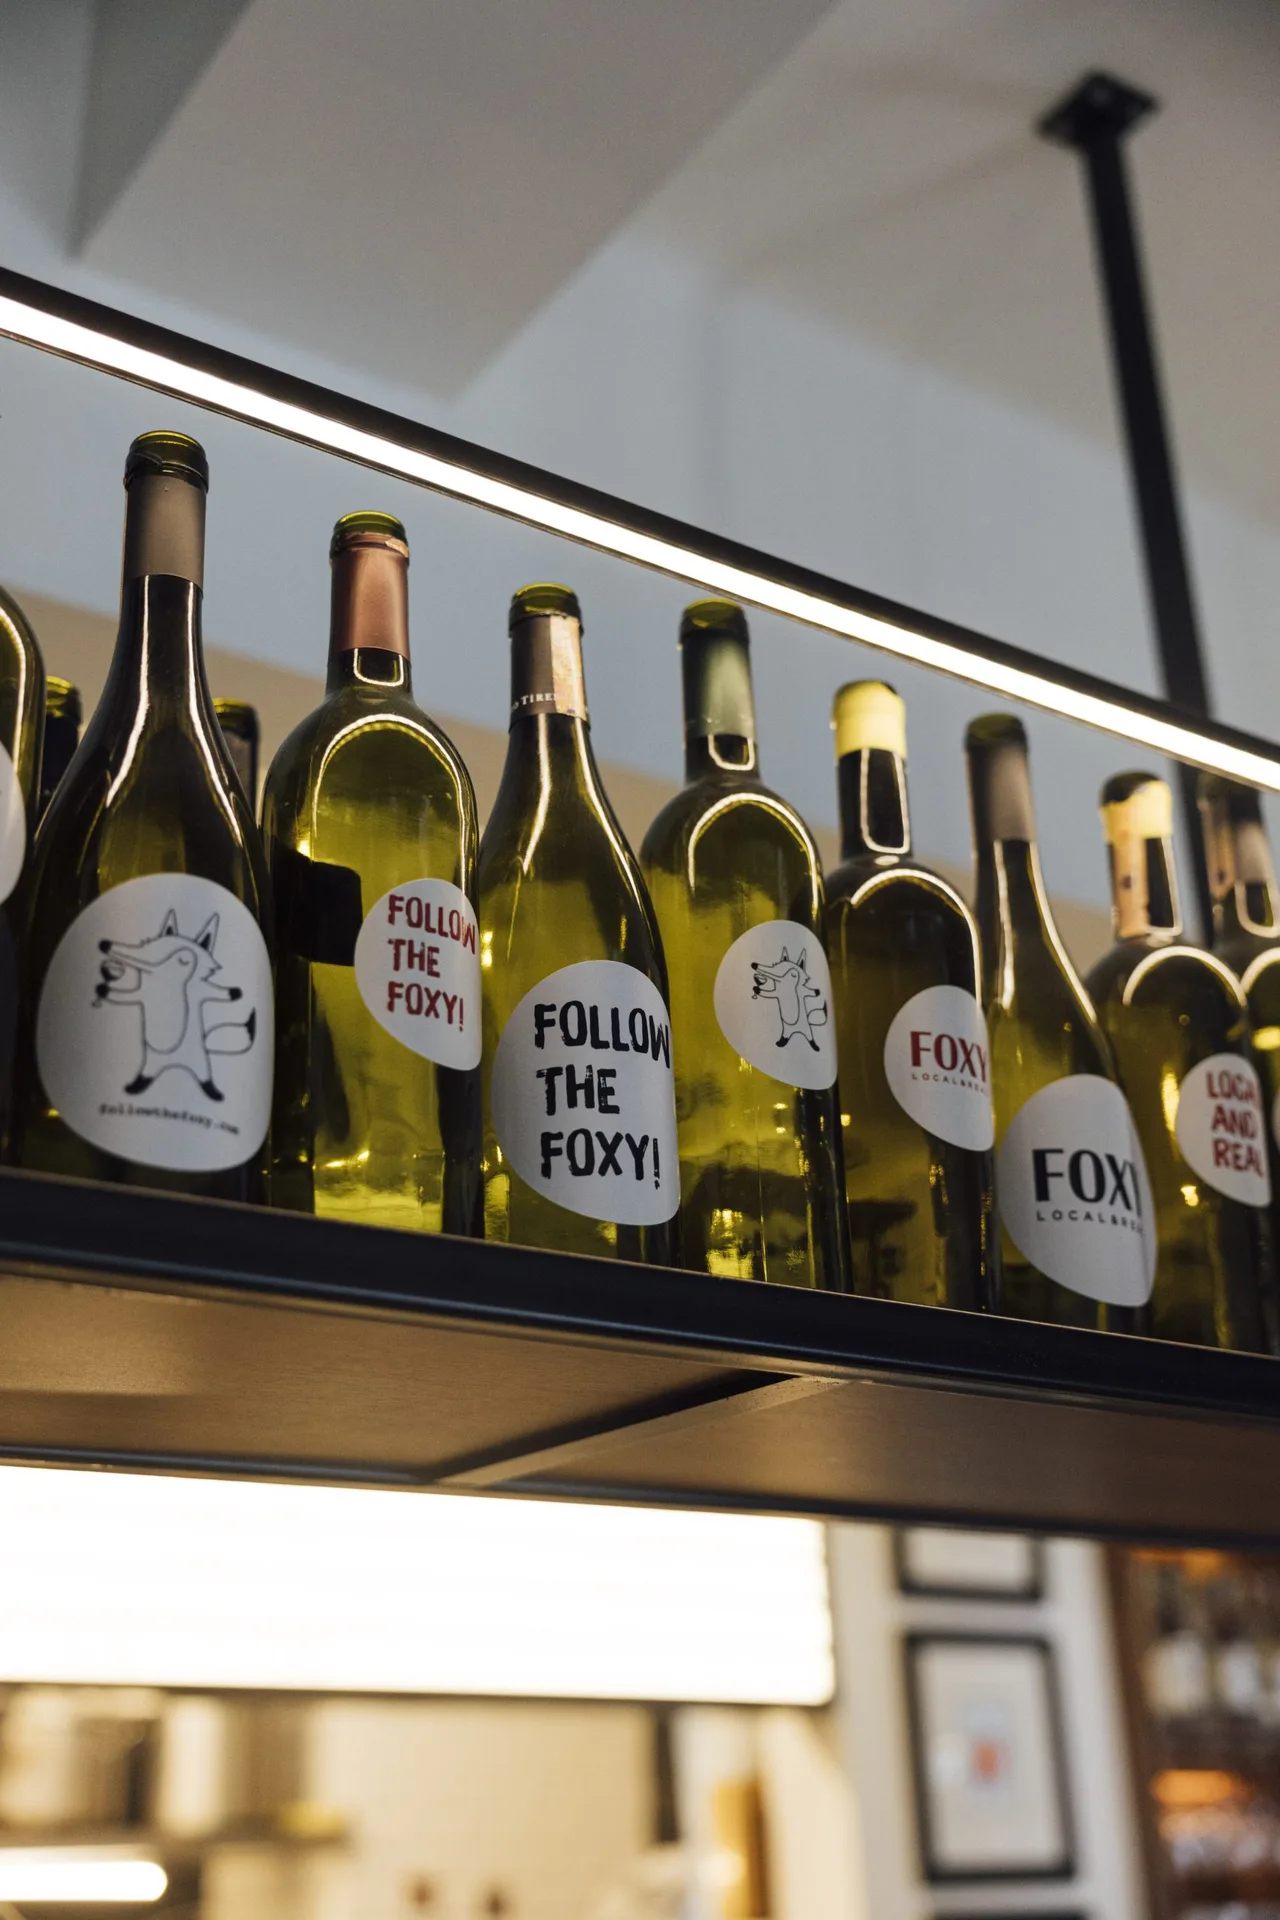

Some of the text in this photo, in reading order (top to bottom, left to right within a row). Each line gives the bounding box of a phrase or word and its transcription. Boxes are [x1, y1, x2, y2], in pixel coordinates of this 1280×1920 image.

[388, 894, 476, 954] FOLLOW
[388, 938, 441, 978] THE
[387, 981, 464, 1032] FOXY!
[534, 1000, 670, 1068] FOLLOW
[910, 1031, 987, 1083] FOXY
[536, 1064, 620, 1116] THE
[1211, 1104, 1258, 1139] AND
[540, 1128, 660, 1190] FOXY!
